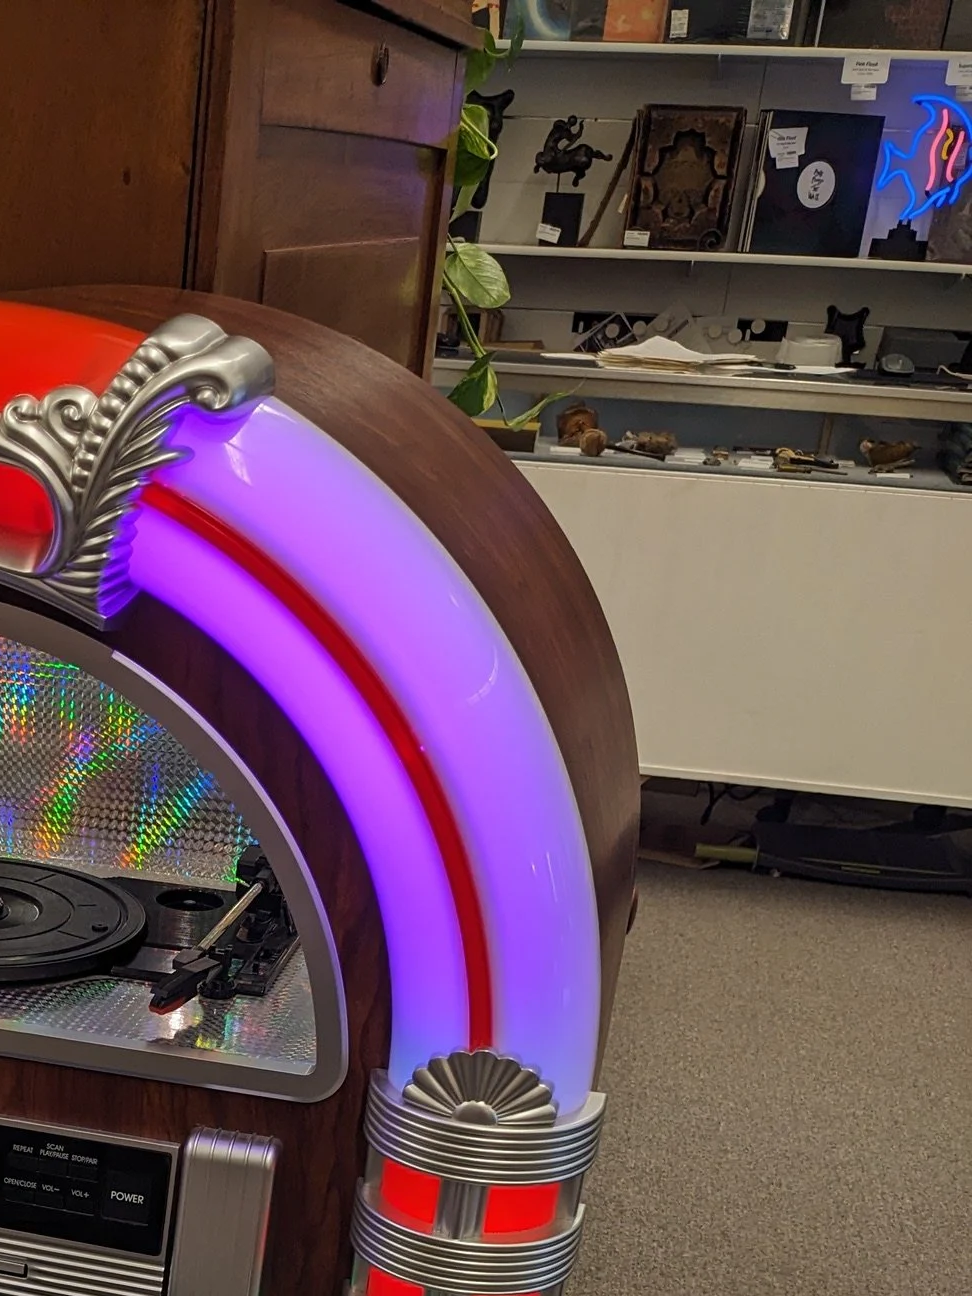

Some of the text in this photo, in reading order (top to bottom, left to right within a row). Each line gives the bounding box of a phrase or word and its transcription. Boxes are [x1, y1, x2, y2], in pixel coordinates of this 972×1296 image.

[46, 1143, 64, 1152] SCAN
[13, 1144, 98, 1165] REPEAT PLAY/PAUSE STOP/PAIR
[4, 1177, 38, 1189] OPEN/CLOSE
[110, 1190, 144, 1205] POWER
